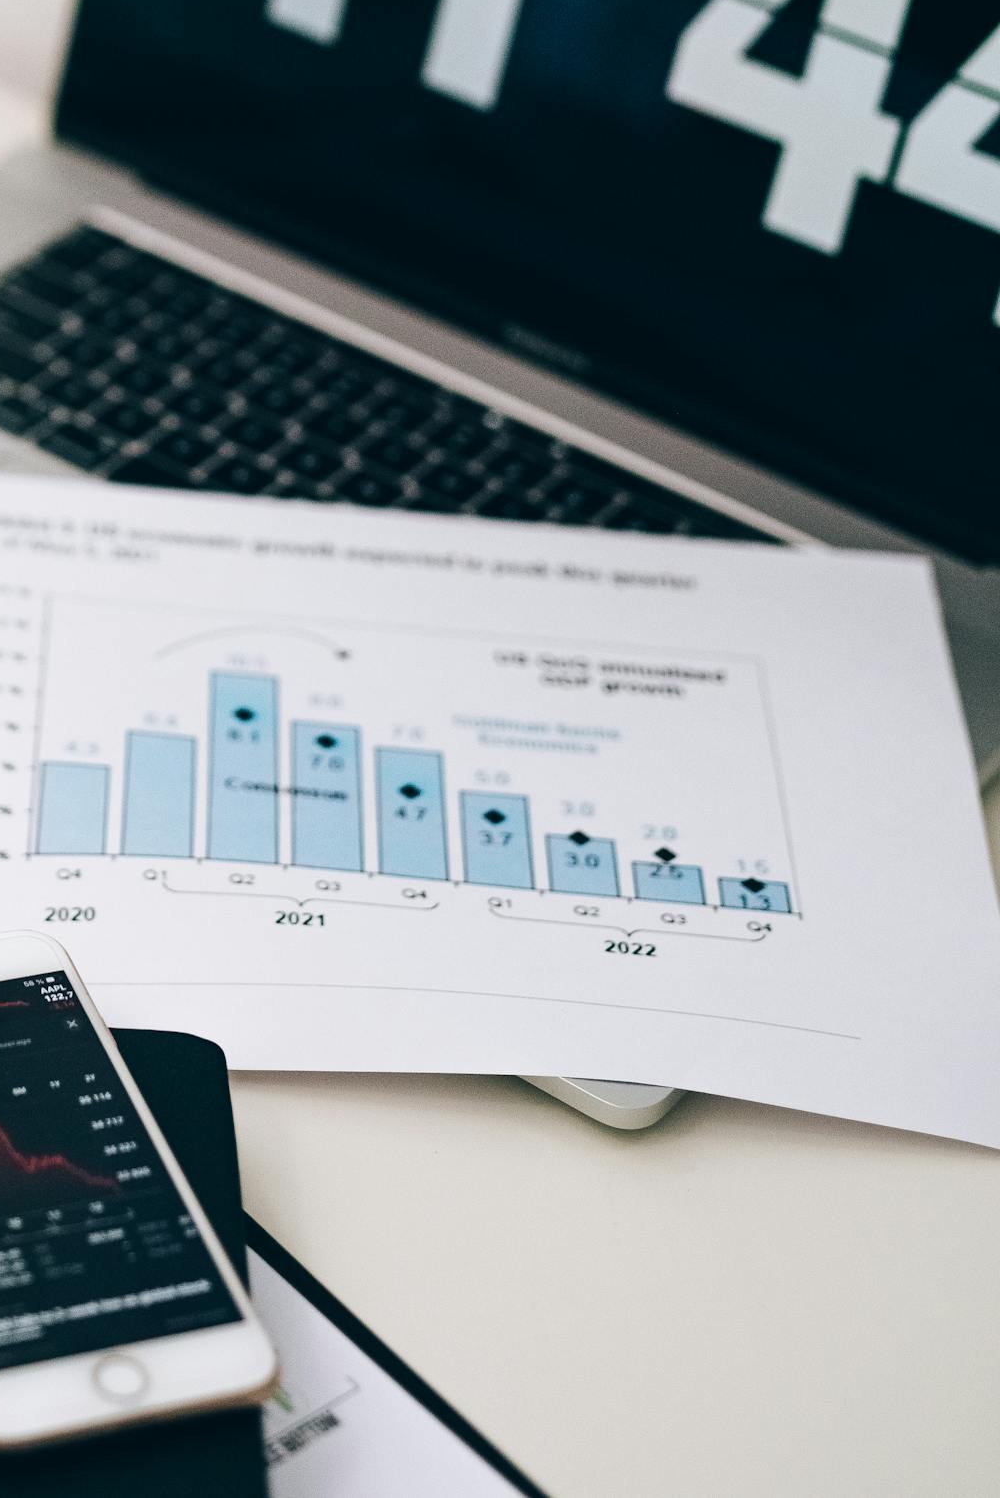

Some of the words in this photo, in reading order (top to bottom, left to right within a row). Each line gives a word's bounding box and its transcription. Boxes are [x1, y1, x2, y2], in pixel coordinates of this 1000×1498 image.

[56, 866, 83, 882] Q4
[143, 867, 169, 882] Q1
[228, 871, 256, 886] Q2
[314, 878, 342, 893] Q3
[401, 887, 428, 900] Q4
[487, 895, 513, 910] Q1
[573, 903, 601, 918] Q2
[660, 911, 688, 926] Q3
[746, 920, 773, 933] Q4
[44, 906, 96, 923] 2020
[275, 910, 327, 928] 2021
[604, 939, 658, 958] 2022
[40, 984, 68, 996] AAPL
